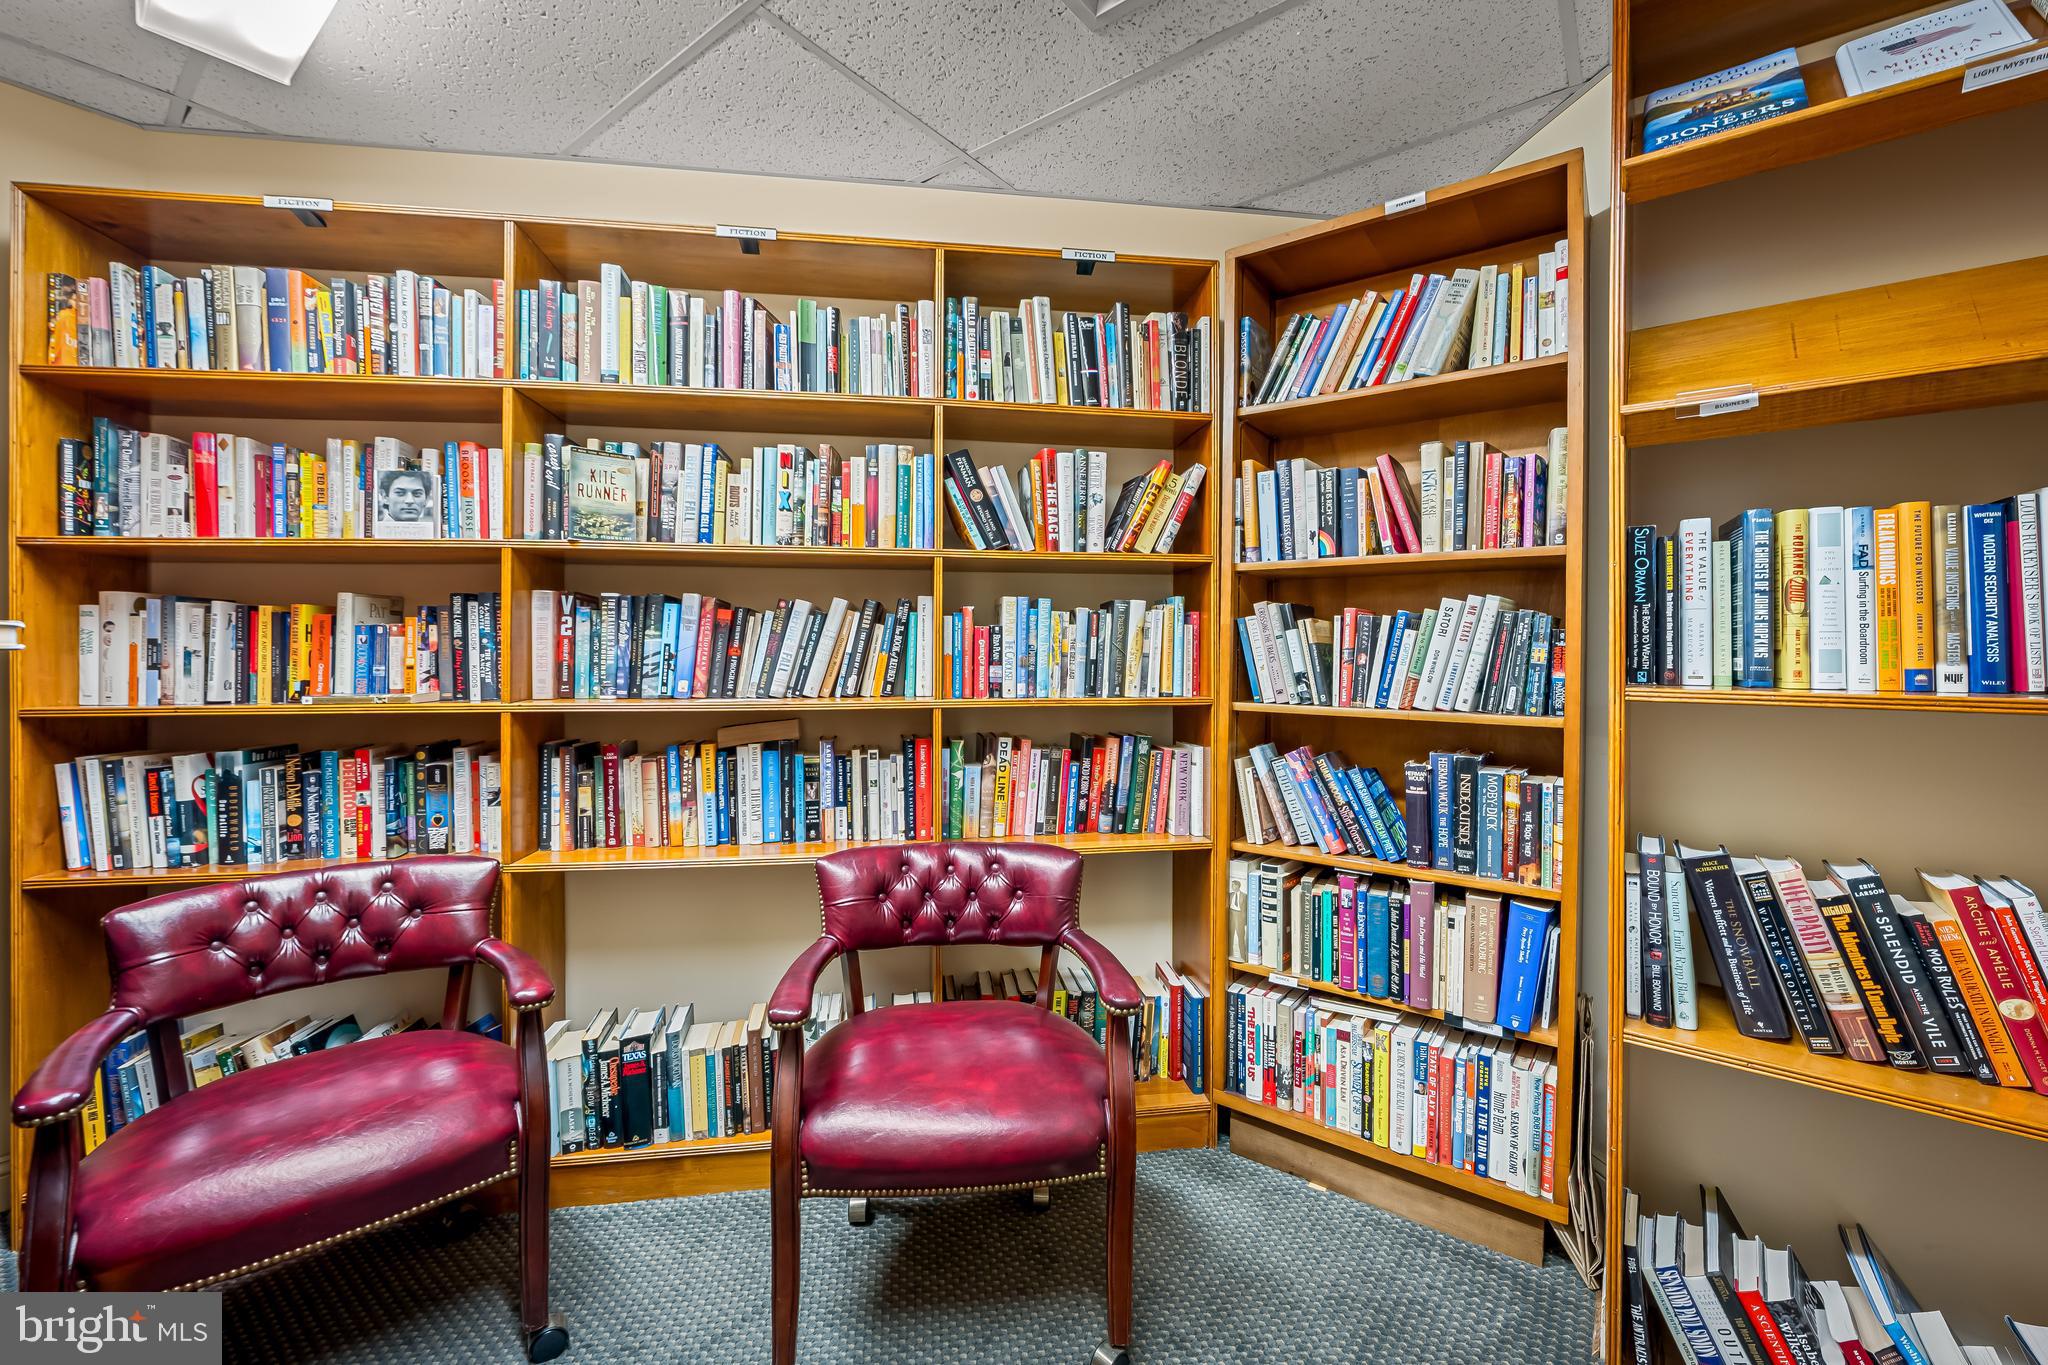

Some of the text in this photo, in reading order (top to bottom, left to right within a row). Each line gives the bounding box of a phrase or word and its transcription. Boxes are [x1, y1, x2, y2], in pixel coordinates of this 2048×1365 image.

[1973, 65, 2001, 79] LIGHT
[1655, 98, 1796, 146] PIONEERS
[278, 199, 319, 207] FICTION
[730, 229, 766, 237] FICTION
[1074, 251, 1107, 260] FICTION
[333, 290, 346, 355] Rashi's Daughters
[369, 279, 385, 352] CARVED IN BONE
[1174, 345, 1187, 399] BLONDE
[1714, 399, 1750, 409] BUSINESS
[317, 486, 325, 504] BELL
[461, 450, 470, 491] BROOKS
[577, 482, 628, 503] RUNNER
[589, 468, 618, 485] KITE
[729, 485, 740, 508] ROOTS
[1078, 455, 1087, 506] ANNE PERRY
[1325, 471, 1334, 493] RABBIT
[464, 500, 474, 532] HORSE
[1047, 482, 1059, 540] THE RACE
[1282, 498, 1293, 554] FULL DRESS GRAY
[1325, 500, 1333, 514] RICH
[1634, 528, 1649, 602] SUZE ORMAN
[1685, 532, 1693, 601] EVERYTHING
[1793, 535, 1803, 575] ROARING
[1859, 544, 1868, 568] FAD
[1878, 513, 1895, 585] FREAKONOMICS
[1754, 530, 1769, 658] THE GHOSTS OF JOHNS HOPKINS
[1946, 548, 1960, 666] VALUE INVESTING MASTERS
[1983, 534, 1999, 662] MODERN SECURITY ANALYSIS
[2020, 500, 2041, 665] LOUIS RUKEYSER'S BOOK OF LISTS
[1438, 606, 1453, 637] SATORI
[1459, 621, 1474, 643] TEXAS
[1642, 603, 1650, 669] THE ROAD TO WEALTH
[1857, 571, 1869, 665] Surfing in the Boardroom
[285, 757, 302, 811] Nelson DeMille
[342, 762, 356, 818] DEIGHTON
[918, 763, 927, 788] Moriarty
[997, 741, 1009, 801] DEAD LINE
[1178, 752, 1188, 802] NEW YORK
[228, 785, 239, 851] UNDERWORLD
[750, 788, 761, 822] THERAPY
[1438, 757, 1449, 848] HERMAN WOUK THE HOPE
[1486, 775, 1498, 830] MOBY-DICK
[1647, 870, 1661, 944] BOUND BY HONOR
[1855, 888, 1884, 898] LARSON
[1477, 906, 1487, 974] CARL SANDBURG
[1671, 881, 1688, 1005] Sanctuary Emily Rapp Black
[1704, 879, 1717, 908] Warren
[1713, 909, 1727, 936] Buffett
[1722, 938, 1730, 948] and
[1728, 958, 1744, 991] Business
[1741, 1000, 1753, 1015] Life
[1725, 899, 1760, 990] THE SNOWBALL
[1963, 895, 1988, 937] ARCHIE
[1986, 948, 2014, 989] AMÉLIE
[1652, 965, 1661, 1010] BILL BONANNO
[1831, 914, 1903, 1043] The Adventures of Conan Doyle
[1874, 902, 1947, 1048] THE SPLENDID AND THE VILE
[1926, 948, 1965, 1010] MOB RULES
[609, 1057, 619, 1096] Chesapeake
[622, 1051, 647, 1062] TEXAS
[1267, 1042, 1275, 1067] HITLER
[1429, 1077, 1436, 1087] OF
[1477, 1097, 1487, 1158] AT THE TURN
[1493, 1091, 1507, 1135] Home Team
